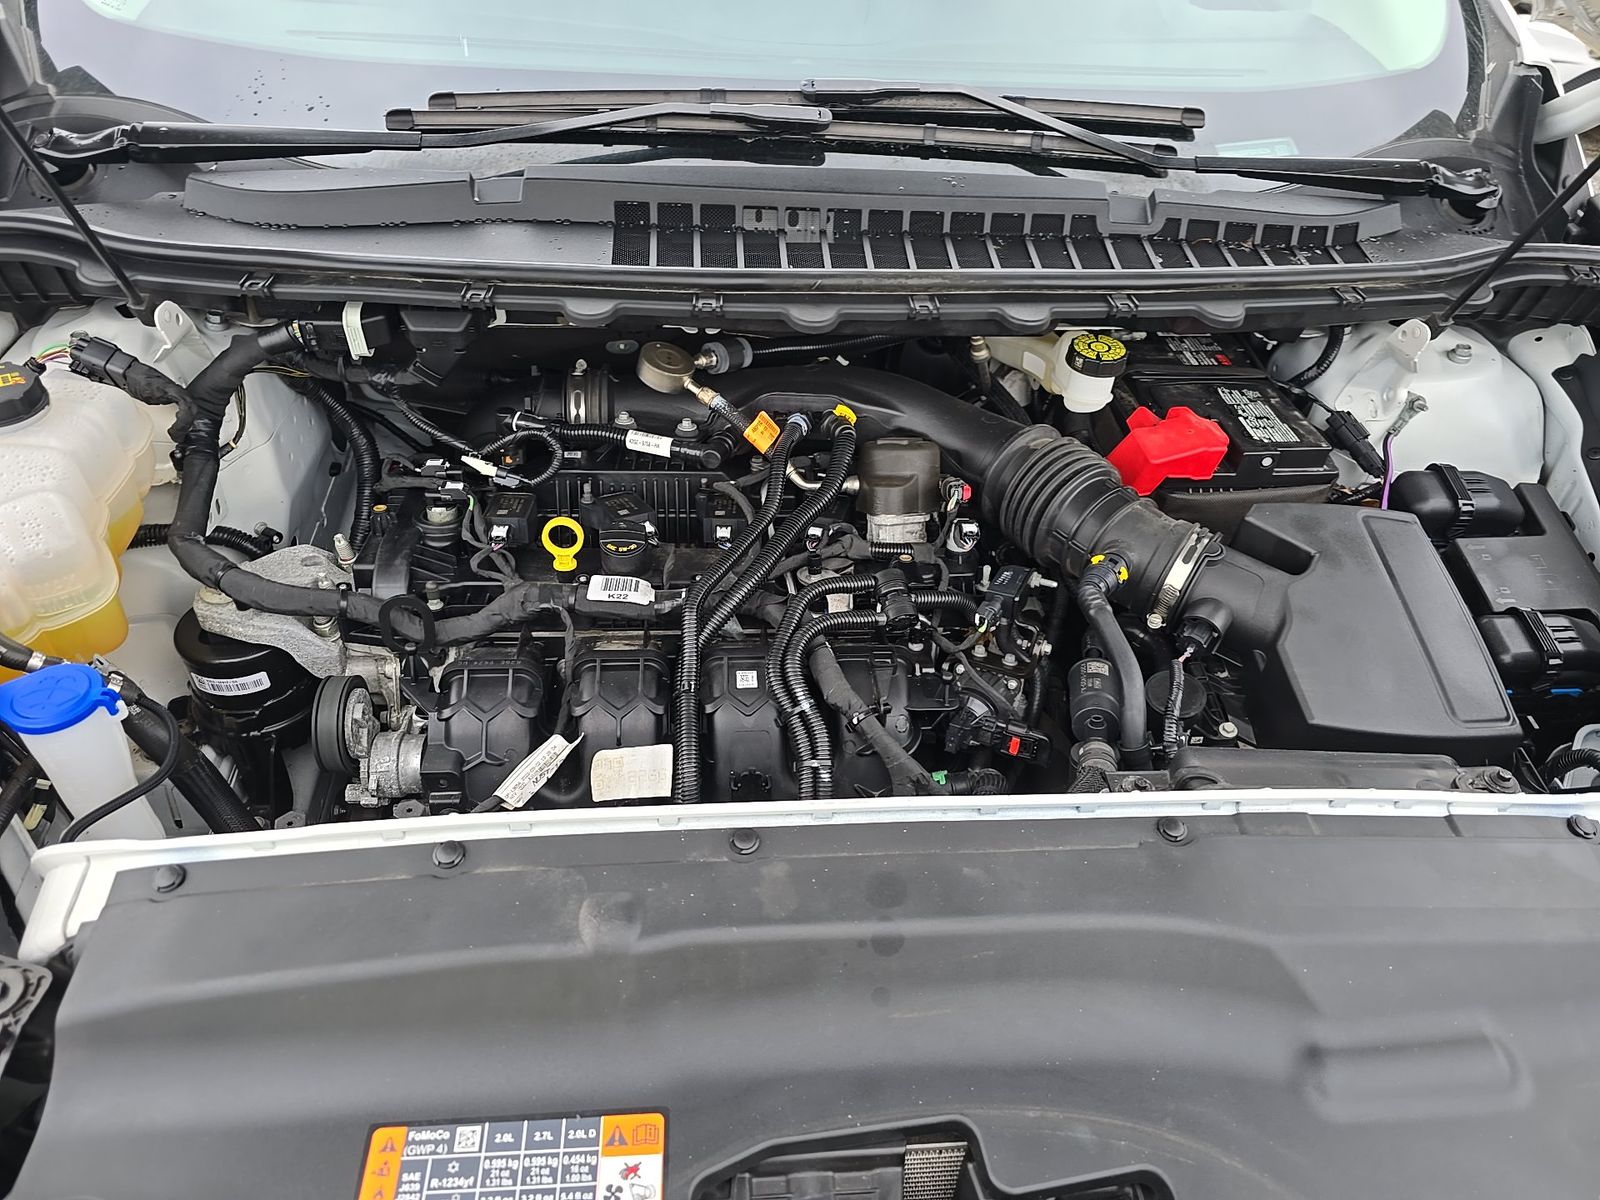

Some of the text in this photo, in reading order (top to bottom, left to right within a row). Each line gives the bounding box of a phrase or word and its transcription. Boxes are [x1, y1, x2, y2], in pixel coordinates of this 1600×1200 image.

[407, 1130, 451, 1141] FoMoCo
[494, 1133, 515, 1142] 2.0L
[533, 1131, 553, 1141] 2.7L
[566, 1128, 597, 1140] 2.0L D
[403, 1143, 448, 1157] (GWP 4)
[507, 1158, 519, 1171] kg
[547, 1156, 559, 1169] kg
[586, 1153, 598, 1166] kg
[401, 1171, 422, 1182] SAE
[429, 1176, 475, 1189] R-1234yf
[398, 1182, 421, 1193] J639
